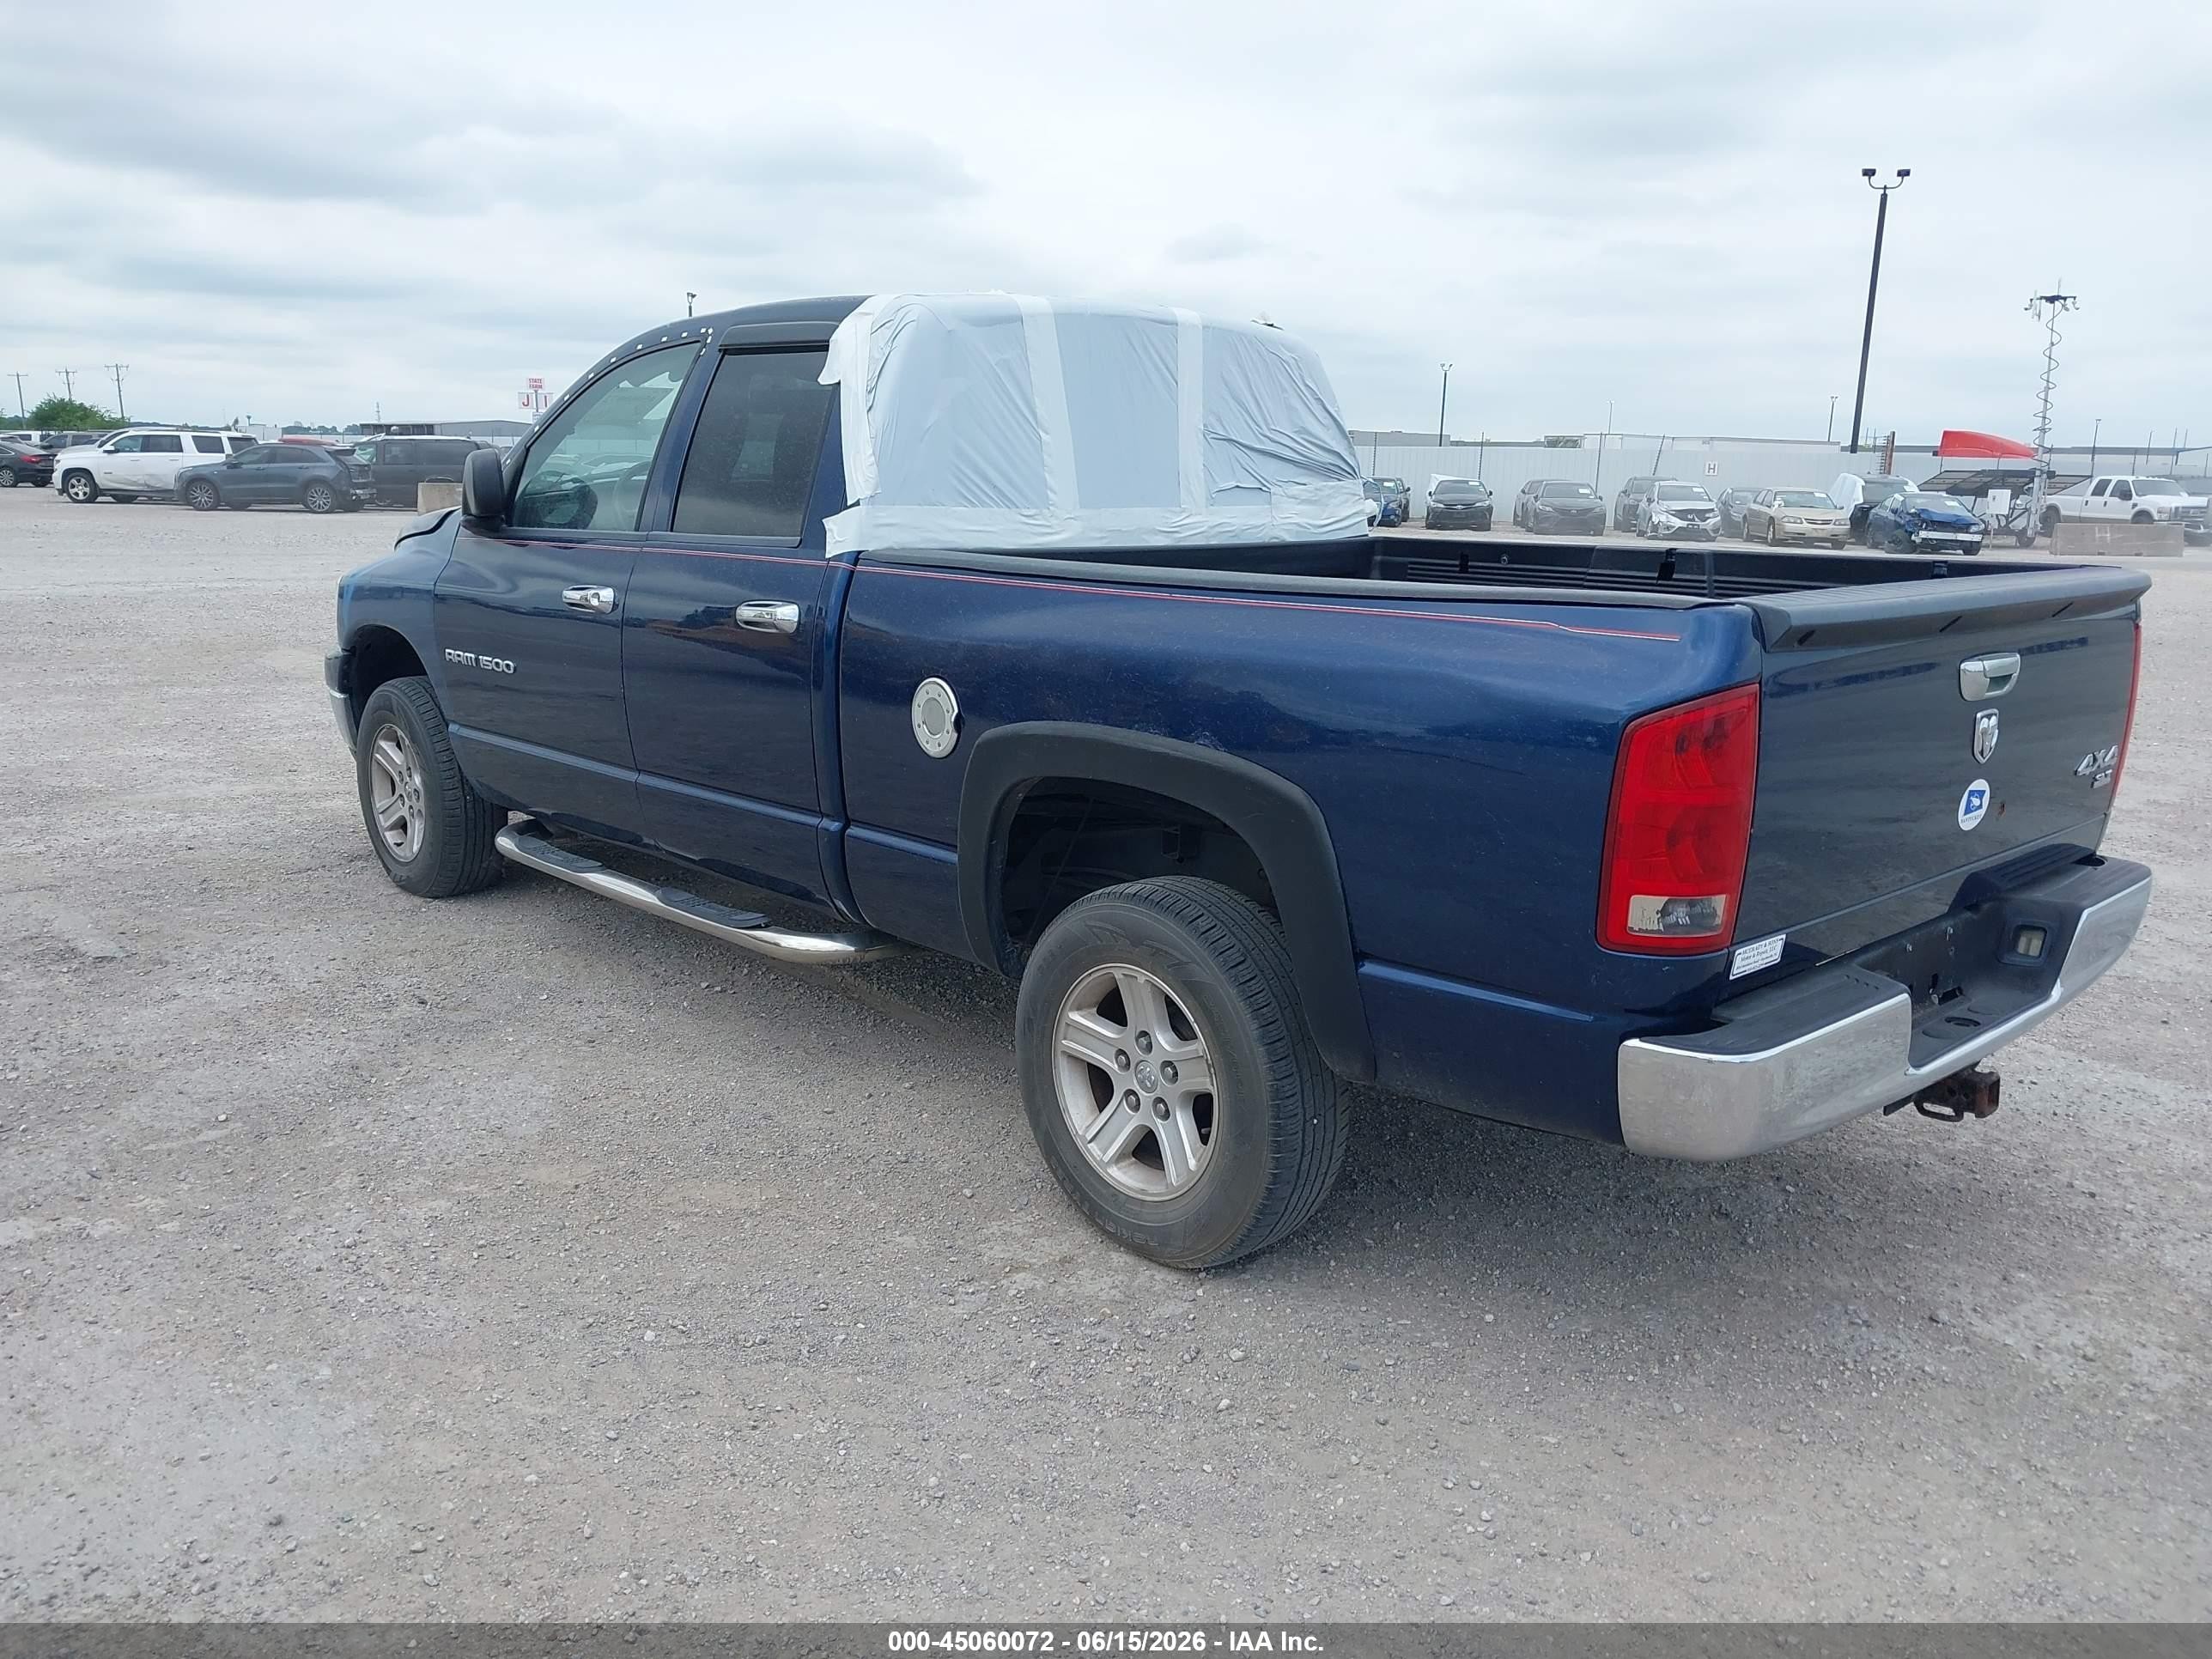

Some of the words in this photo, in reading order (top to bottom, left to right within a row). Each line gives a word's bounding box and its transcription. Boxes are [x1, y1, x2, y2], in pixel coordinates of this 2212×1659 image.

[521, 393, 530, 407] J
[1707, 463, 1717, 474] H
[445, 648, 477, 667] RAM
[478, 655, 515, 674] 1500
